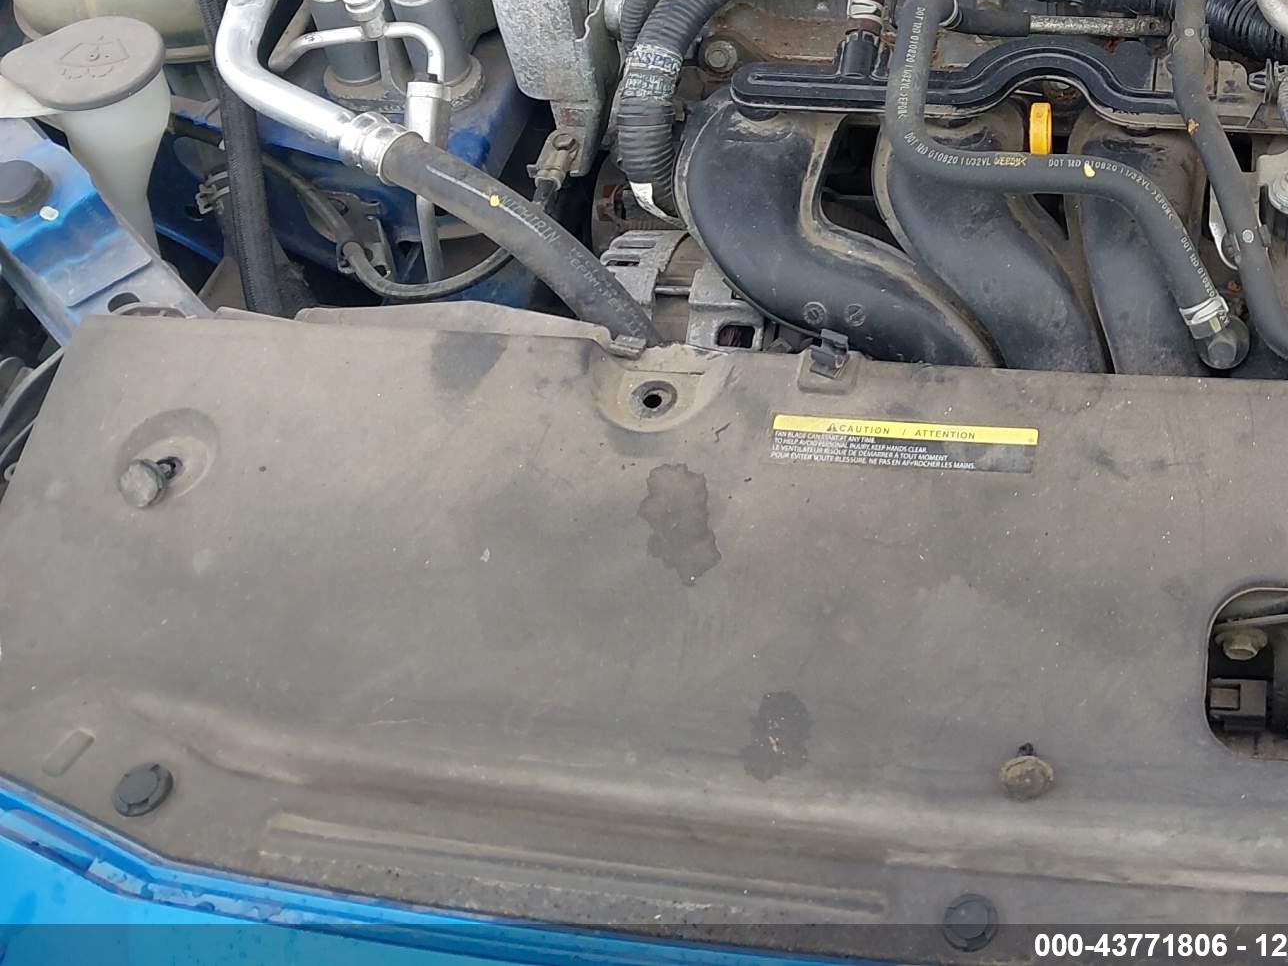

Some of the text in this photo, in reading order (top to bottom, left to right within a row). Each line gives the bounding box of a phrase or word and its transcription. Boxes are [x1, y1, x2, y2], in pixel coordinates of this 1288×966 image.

[500, 195, 560, 244] NICHIRIN
[839, 424, 890, 435] CAUTION
[914, 429, 976, 440] ATTENTION
[780, 444, 823, 454] VENTILATEUR
[823, 446, 847, 455] RISQUE
[848, 448, 857, 456] DE
[899, 451, 917, 460] TOUT
[917, 452, 948, 461] MOMENT
[783, 437, 798, 445] HELP
[799, 438, 817, 446] AVOID
[870, 442, 885, 450] KEEP
[886, 444, 907, 452] HANDS
[878, 457, 891, 465] PAS
[891, 458, 901, 466] EN
[901, 458, 940, 468] APPROCHER
[940, 460, 953, 468] LES
